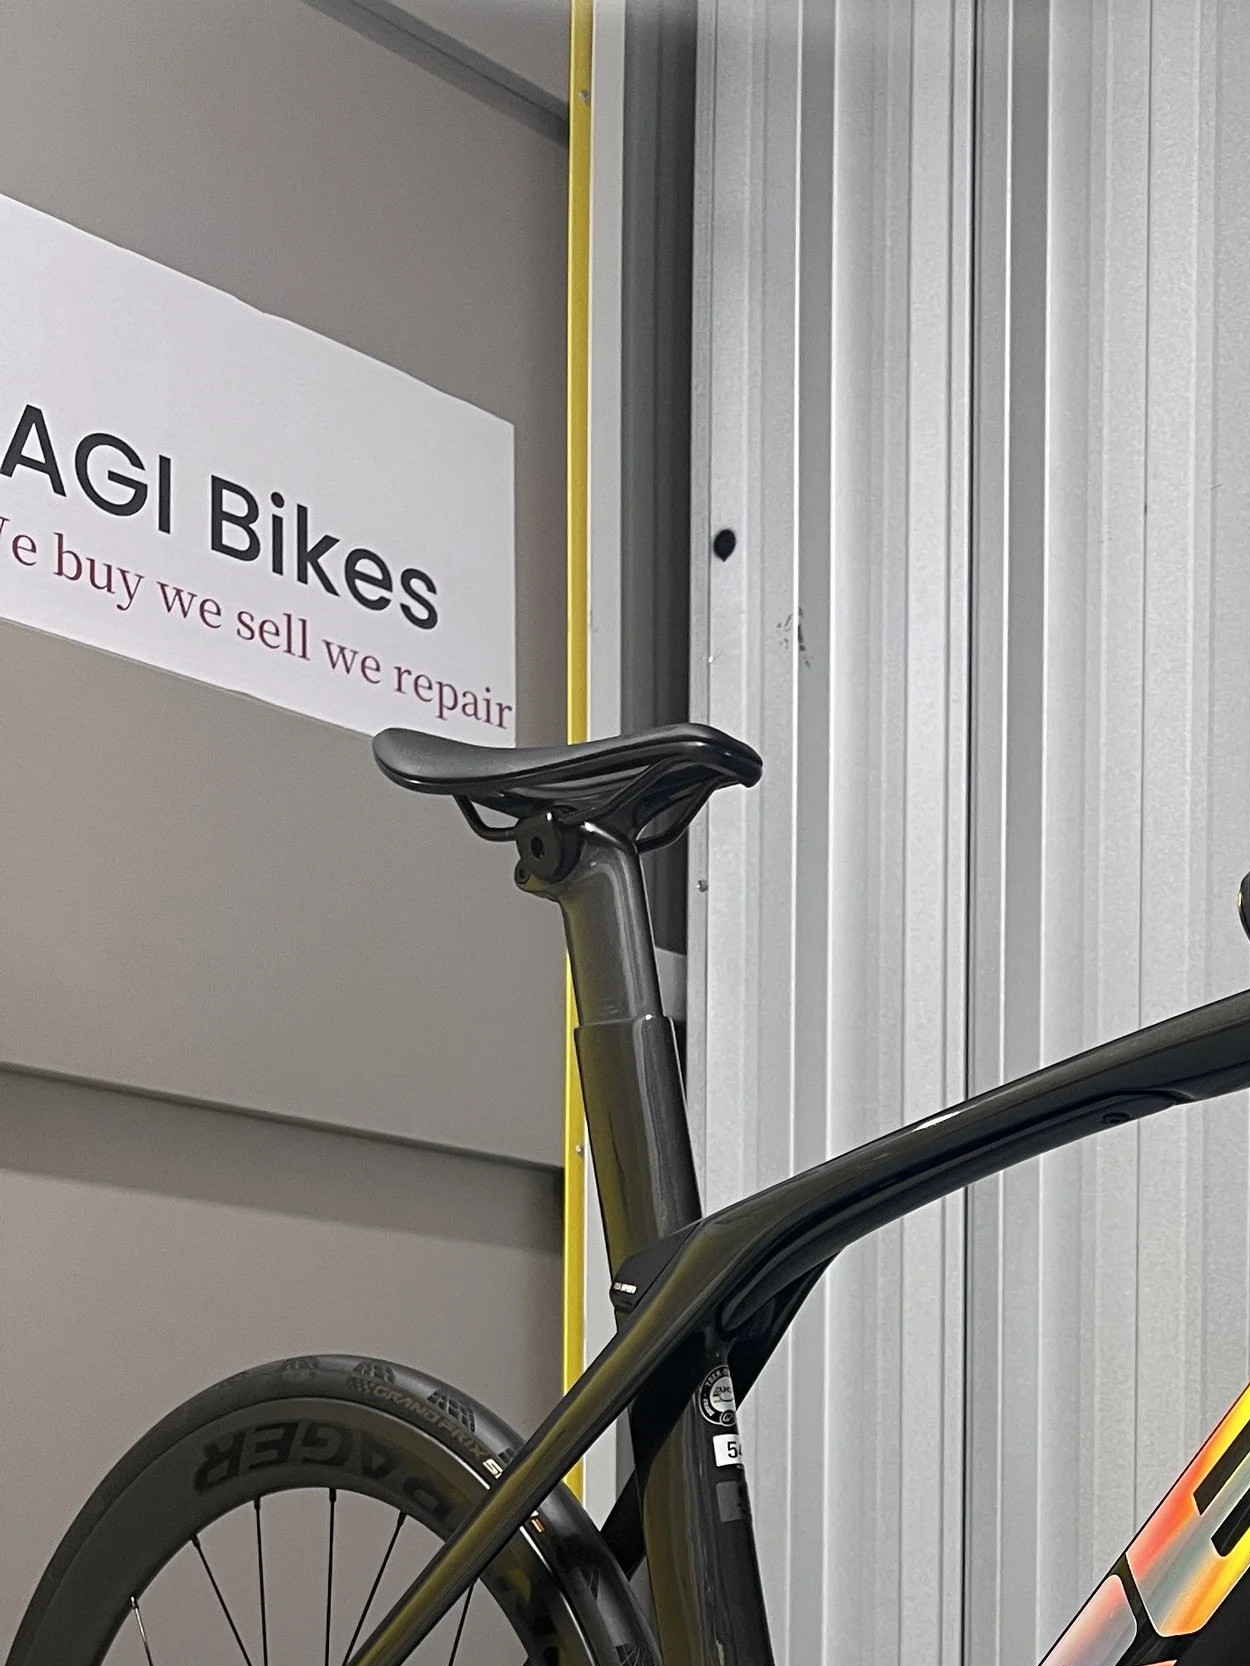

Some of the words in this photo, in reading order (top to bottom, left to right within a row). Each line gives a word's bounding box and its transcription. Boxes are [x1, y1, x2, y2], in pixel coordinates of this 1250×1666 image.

[0, 403, 172, 535] AGI
[210, 474, 439, 631] Bikes
[53, 532, 145, 612] buy
[156, 581, 222, 629] we
[236, 610, 311, 662] sell
[322, 639, 382, 685] we
[393, 666, 513, 730] repair
